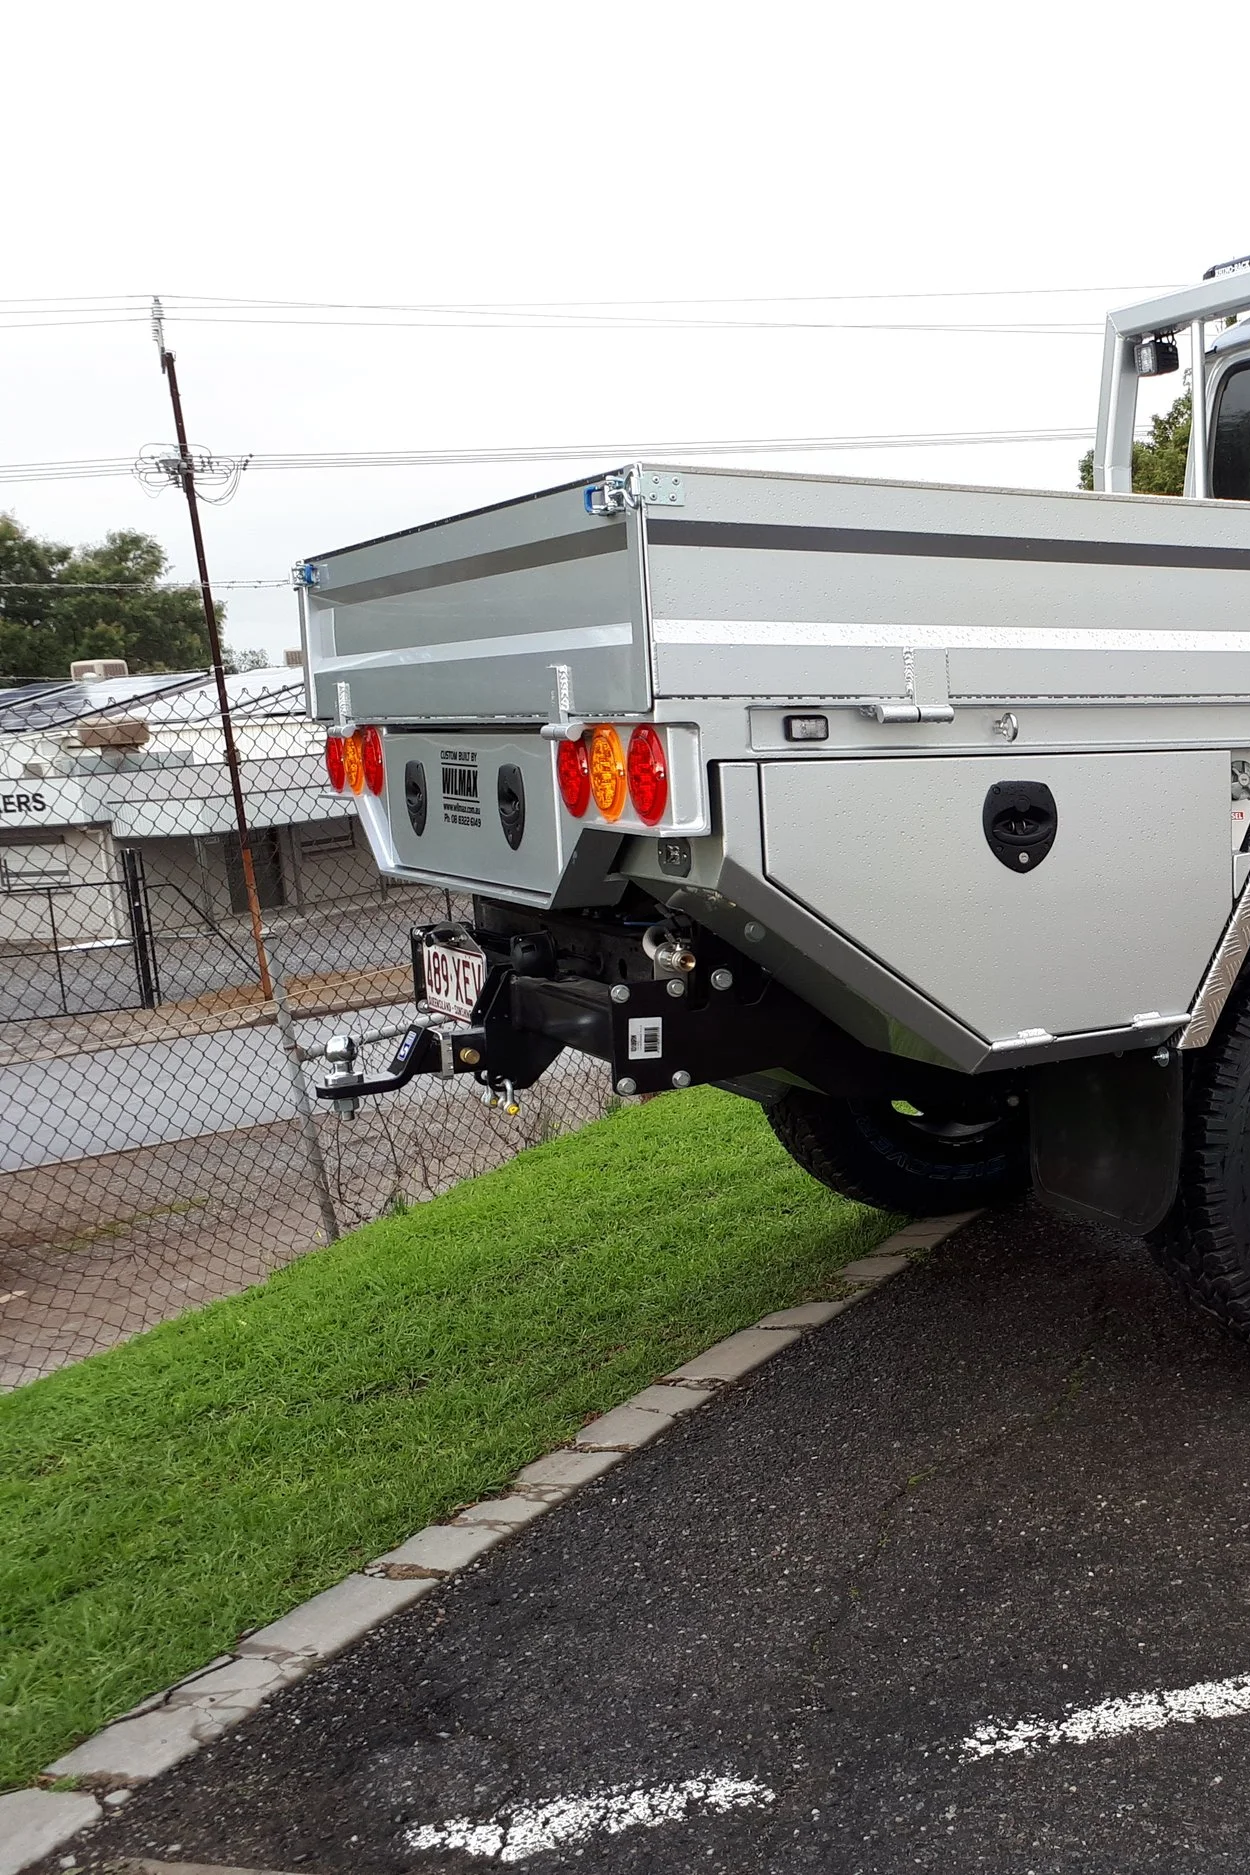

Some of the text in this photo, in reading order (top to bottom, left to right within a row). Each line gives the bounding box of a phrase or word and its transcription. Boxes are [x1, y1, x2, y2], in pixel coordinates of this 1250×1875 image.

[441, 750, 477, 761] CUSTOM BUILT BY
[442, 767, 478, 798] WILMAX
[0, 792, 47, 813] ERS
